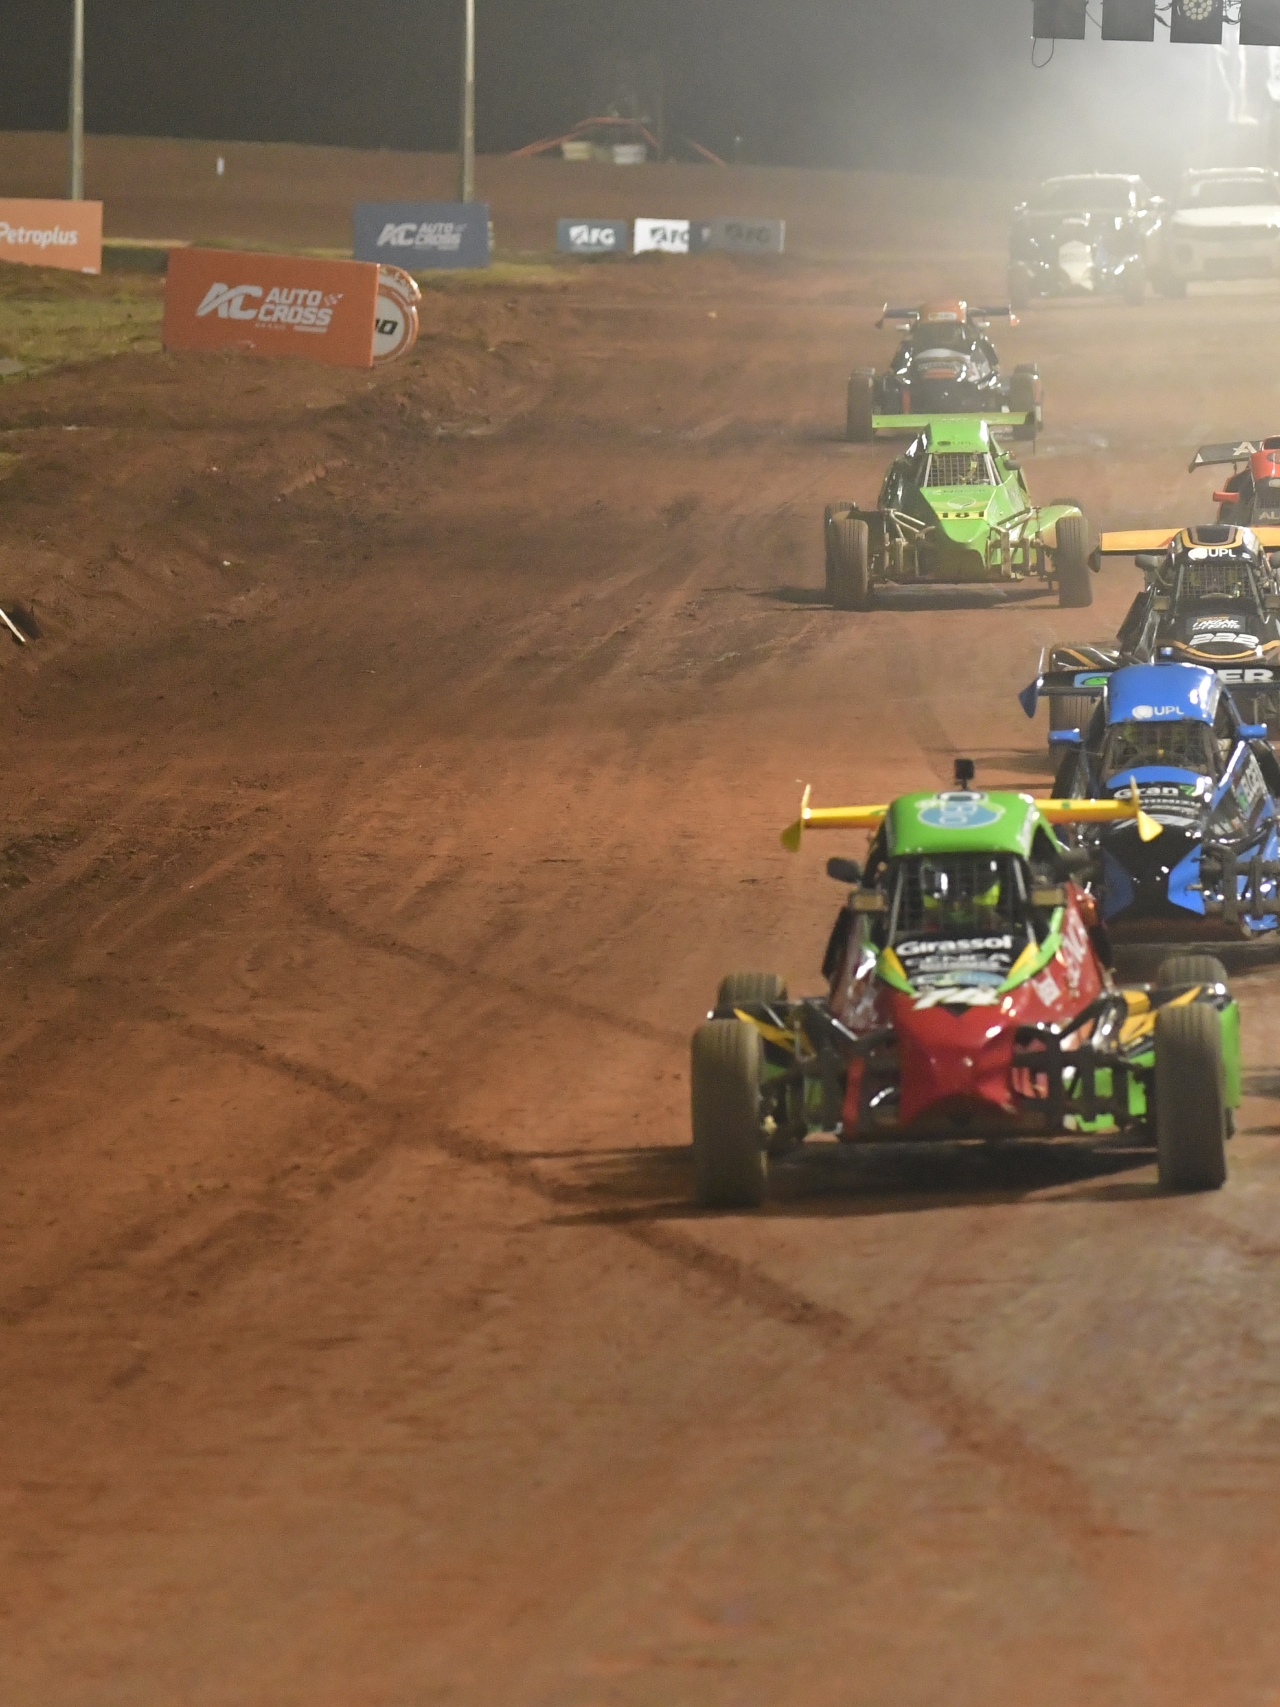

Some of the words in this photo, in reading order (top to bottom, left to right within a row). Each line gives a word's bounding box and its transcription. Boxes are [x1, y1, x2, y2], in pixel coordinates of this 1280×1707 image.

[196, 282, 263, 320] AC
[264, 286, 323, 307] AUTO
[257, 304, 333, 327] CROSS
[1208, 547, 1237, 558] UPL
[1188, 632, 1260, 649] 222
[1154, 705, 1185, 716] UPL
[895, 934, 1013, 957] Girassol
